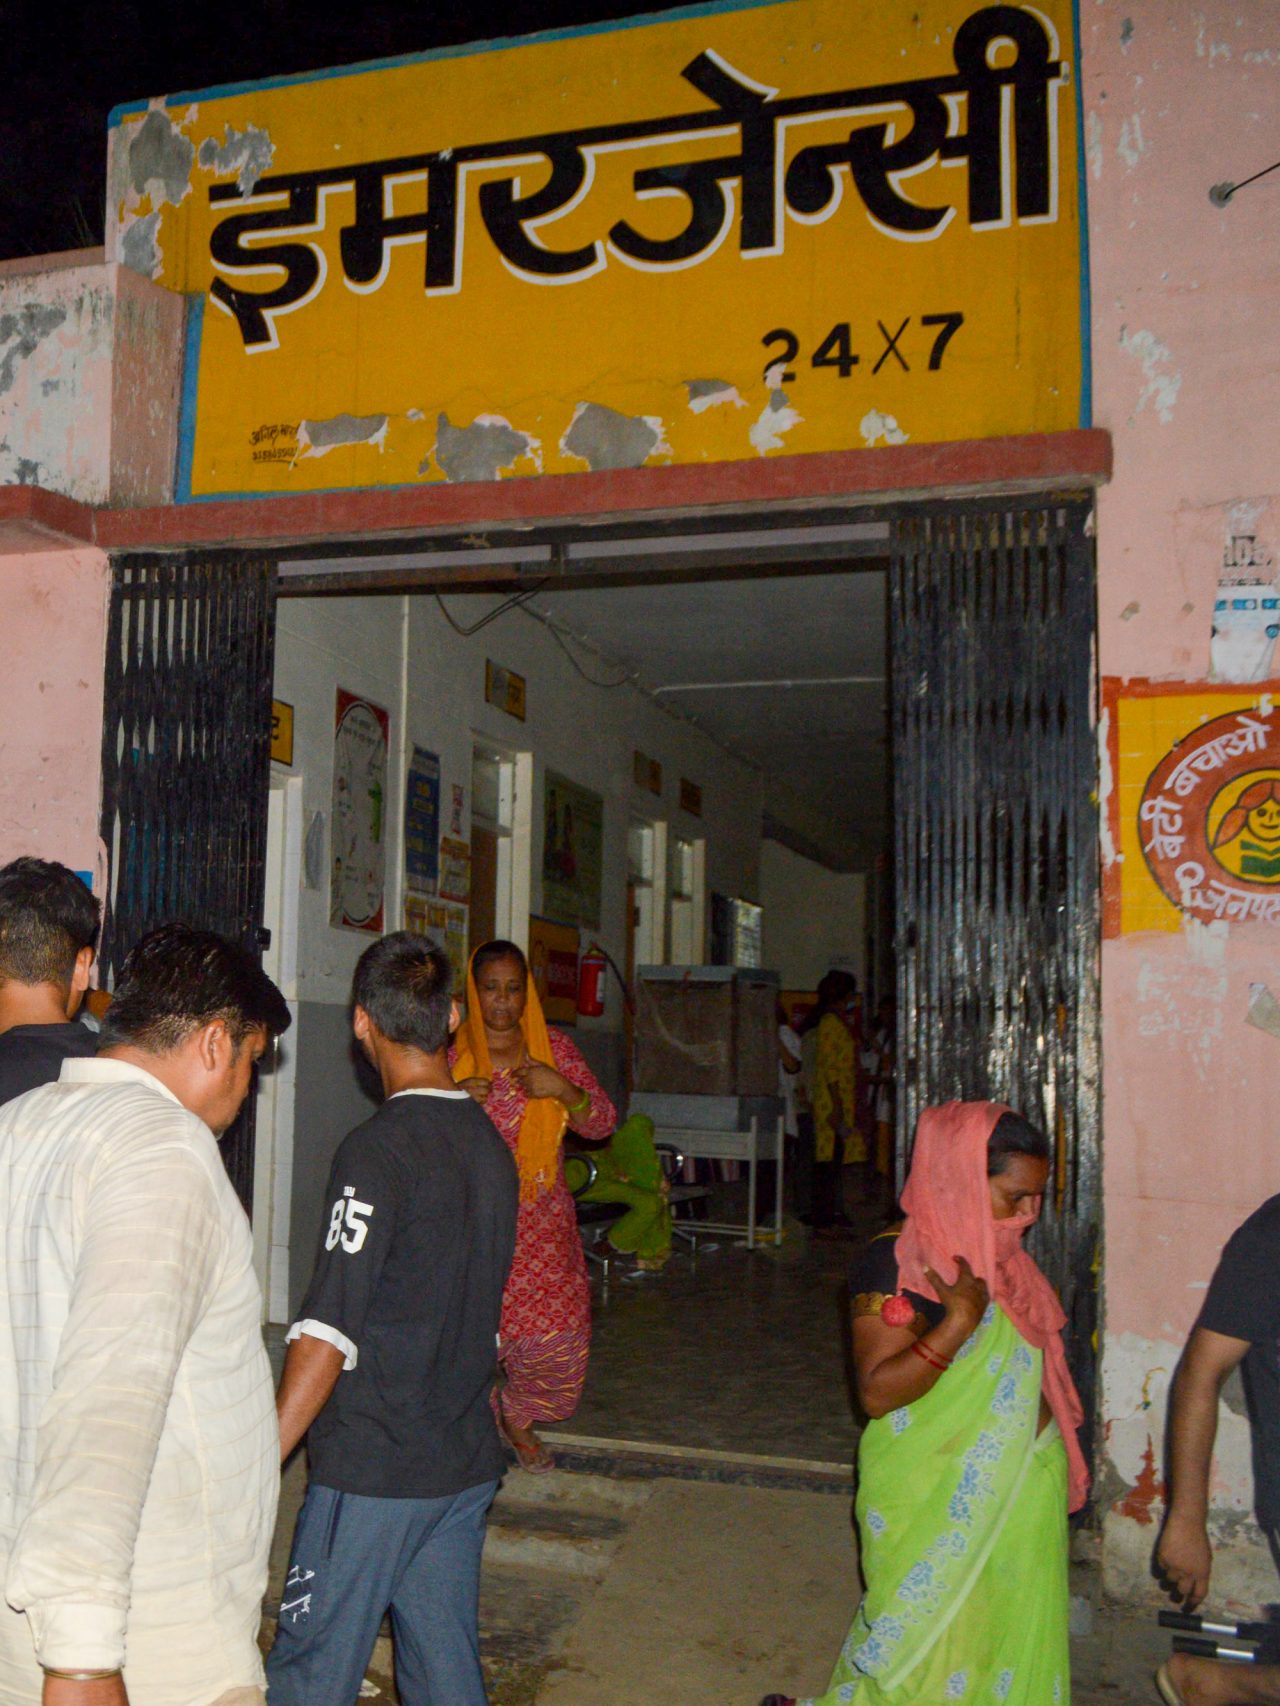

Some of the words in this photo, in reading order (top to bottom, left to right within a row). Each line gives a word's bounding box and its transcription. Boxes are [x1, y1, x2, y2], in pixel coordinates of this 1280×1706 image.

[209, 5, 1065, 352] इमरजेन्सी
[1140, 796, 1185, 860] बेटी
[1164, 716, 1272, 797] बचाओ
[325, 1198, 374, 1254] 85
